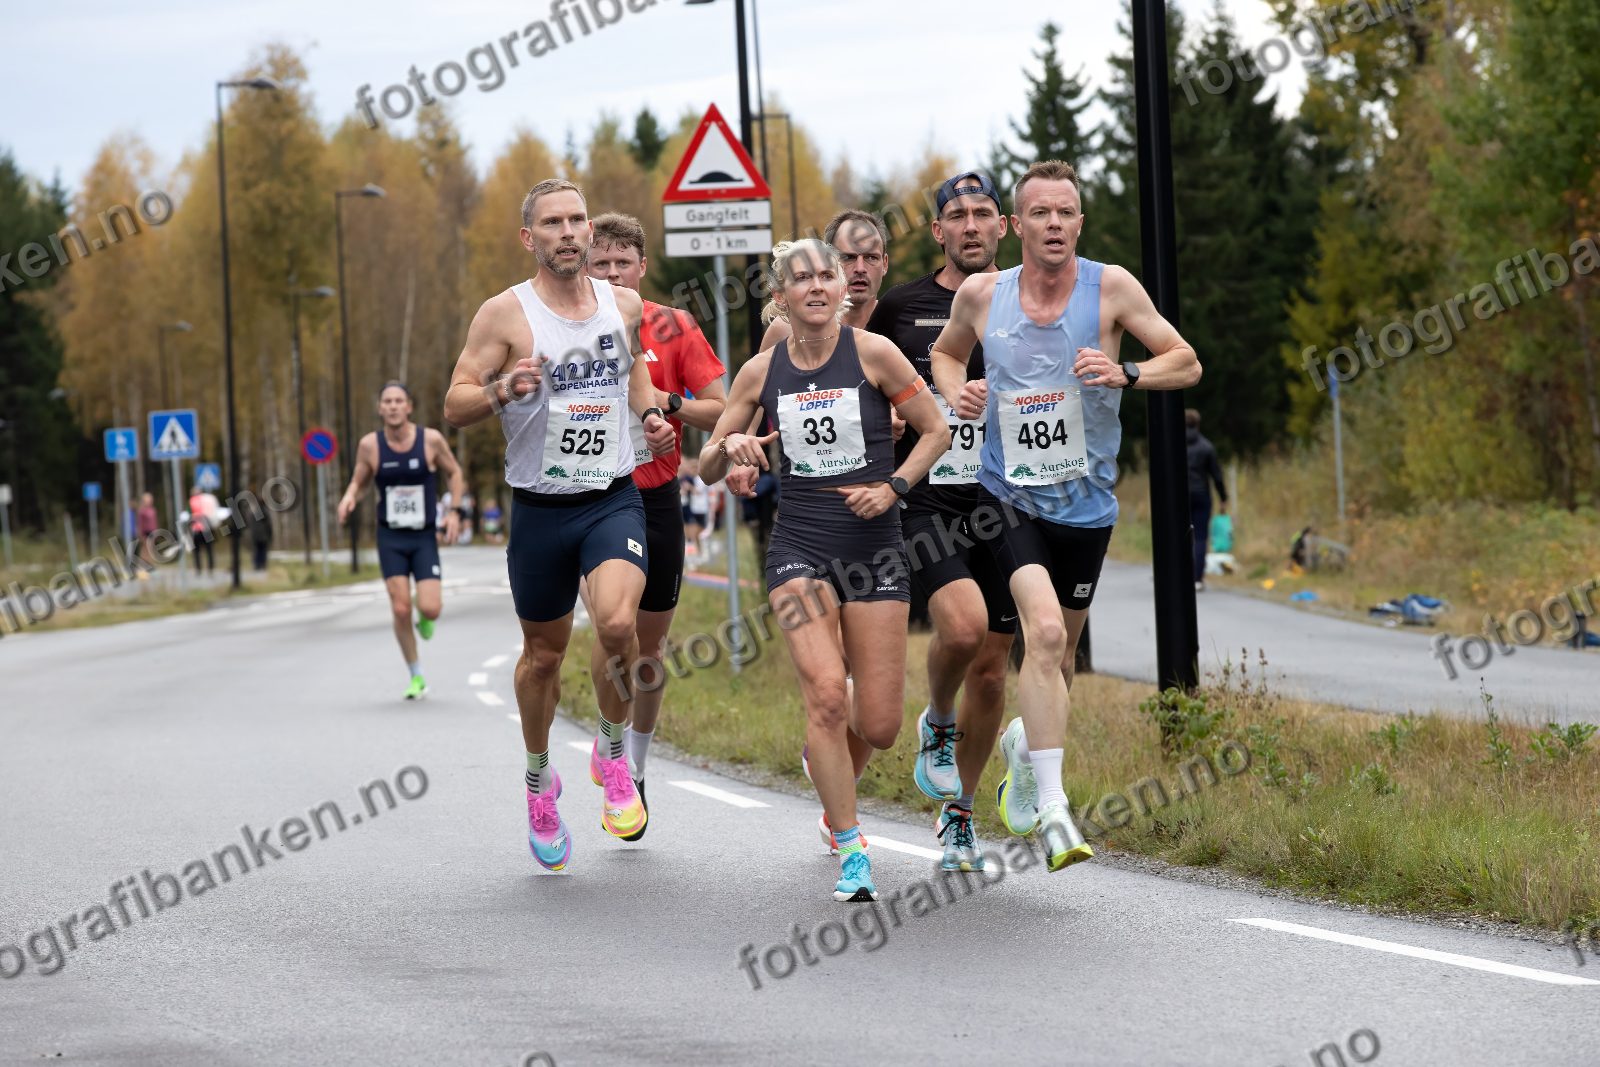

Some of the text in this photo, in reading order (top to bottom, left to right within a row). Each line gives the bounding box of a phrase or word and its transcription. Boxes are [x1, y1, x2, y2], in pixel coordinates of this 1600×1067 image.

[686, 208, 749, 224] Gangfelt
[690, 237, 700, 250] 0
[552, 378, 619, 392] COPENHAGEN
[796, 389, 844, 402] NORGES
[1015, 391, 1065, 405] NORGES
[566, 403, 611, 414] NORGES
[799, 399, 836, 411] LØPET
[1020, 402, 1058, 415] LØPET
[570, 413, 603, 422] LØPET
[803, 416, 837, 446] 33
[1018, 419, 1068, 450] 484
[560, 428, 606, 456] 525
[816, 448, 833, 456] ELITE
[819, 455, 863, 469] Aurskog
[1040, 457, 1085, 473] Aurskog
[572, 467, 615, 481] Aurskog
